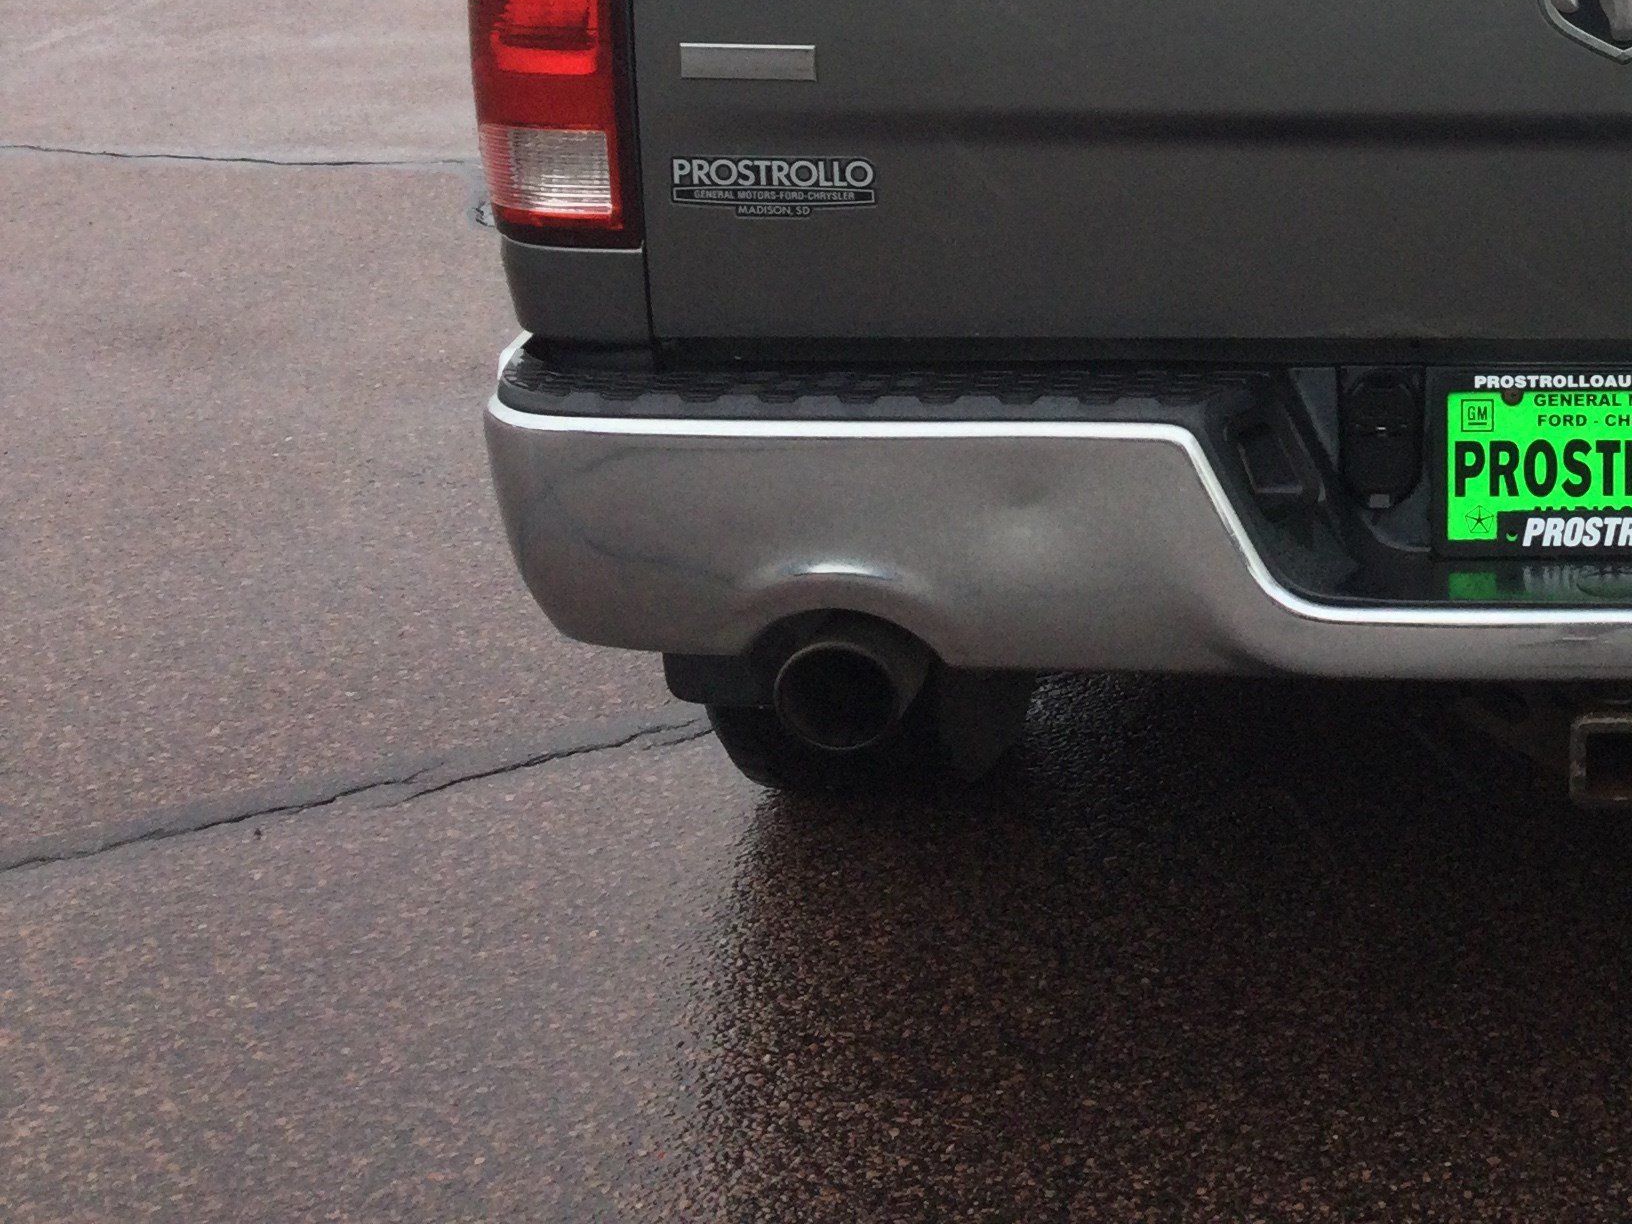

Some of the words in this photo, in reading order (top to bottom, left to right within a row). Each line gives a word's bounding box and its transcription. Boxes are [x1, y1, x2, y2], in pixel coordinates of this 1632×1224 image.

[672, 158, 874, 187] PROSTROLLO
[694, 190, 735, 200] GENERAL
[795, 206, 811, 215] SD
[1533, 393, 1621, 408] GENERAL
[1467, 406, 1488, 421] GM
[1537, 414, 1588, 427] FORD
